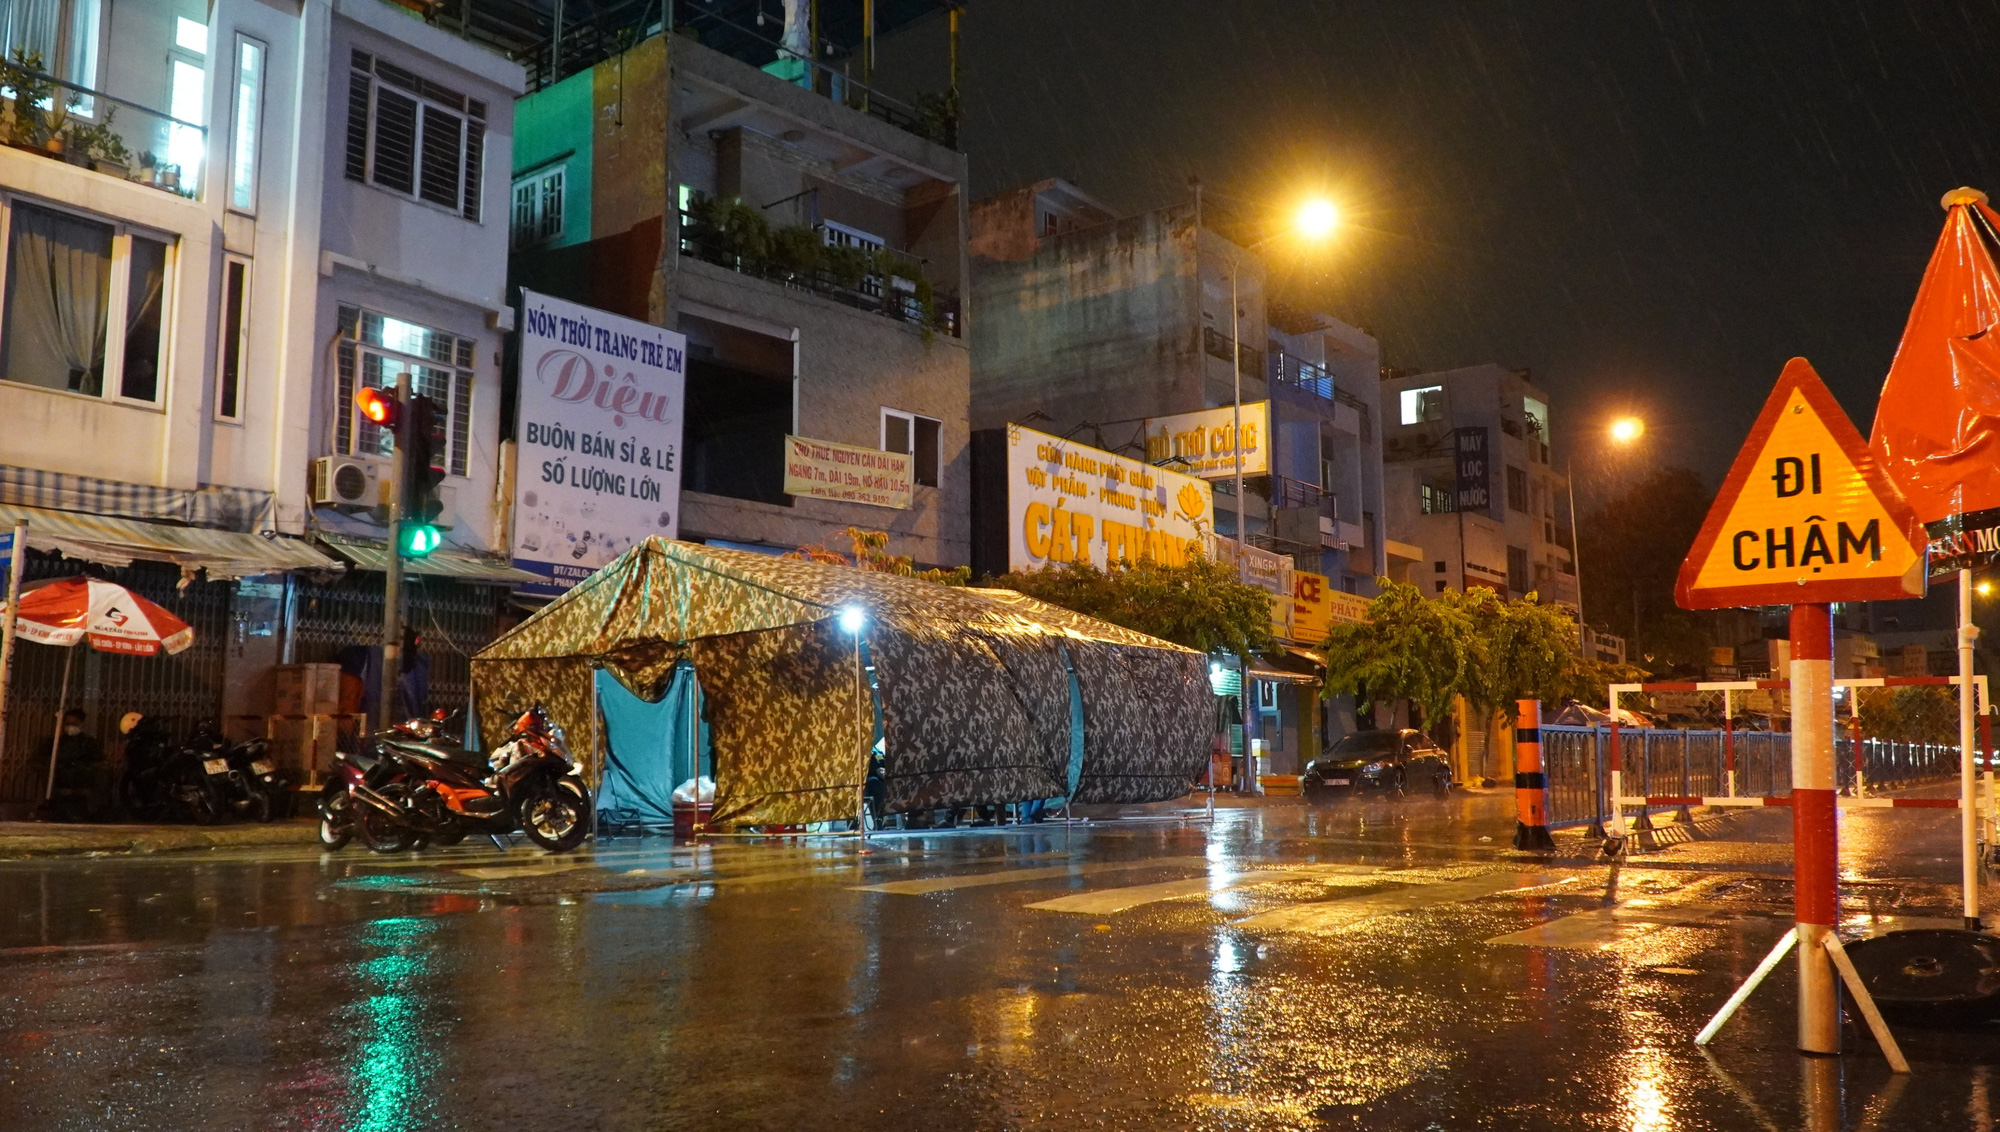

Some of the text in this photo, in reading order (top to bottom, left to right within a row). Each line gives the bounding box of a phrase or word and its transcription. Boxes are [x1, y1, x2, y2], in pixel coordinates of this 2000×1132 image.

[527, 304, 682, 374] NÓN THỜI TRANG TRẺ EM
[536, 349, 673, 430] Diệu
[526, 421, 675, 472] BUÔN BÁN SỈ & LẺ
[1460, 431, 1483, 452] MÁY
[541, 455, 661, 503] SỐ LƯỢNG LỚN
[788, 462, 812, 479] NGANG
[828, 467, 842, 483] DÀI
[1026, 466, 1047, 490] VẬT
[1052, 472, 1087, 498] PHẨM
[1100, 488, 1136, 510] PHONG
[1065, 451, 1098, 475] HÀNG
[1129, 470, 1154, 491] GIÁO
[1462, 460, 1483, 480] LỌC
[1771, 453, 1822, 498] ĐI
[1459, 483, 1487, 506] NƯỚC
[1025, 497, 1094, 566] CÁT
[1732, 515, 1882, 573] CHẬM
